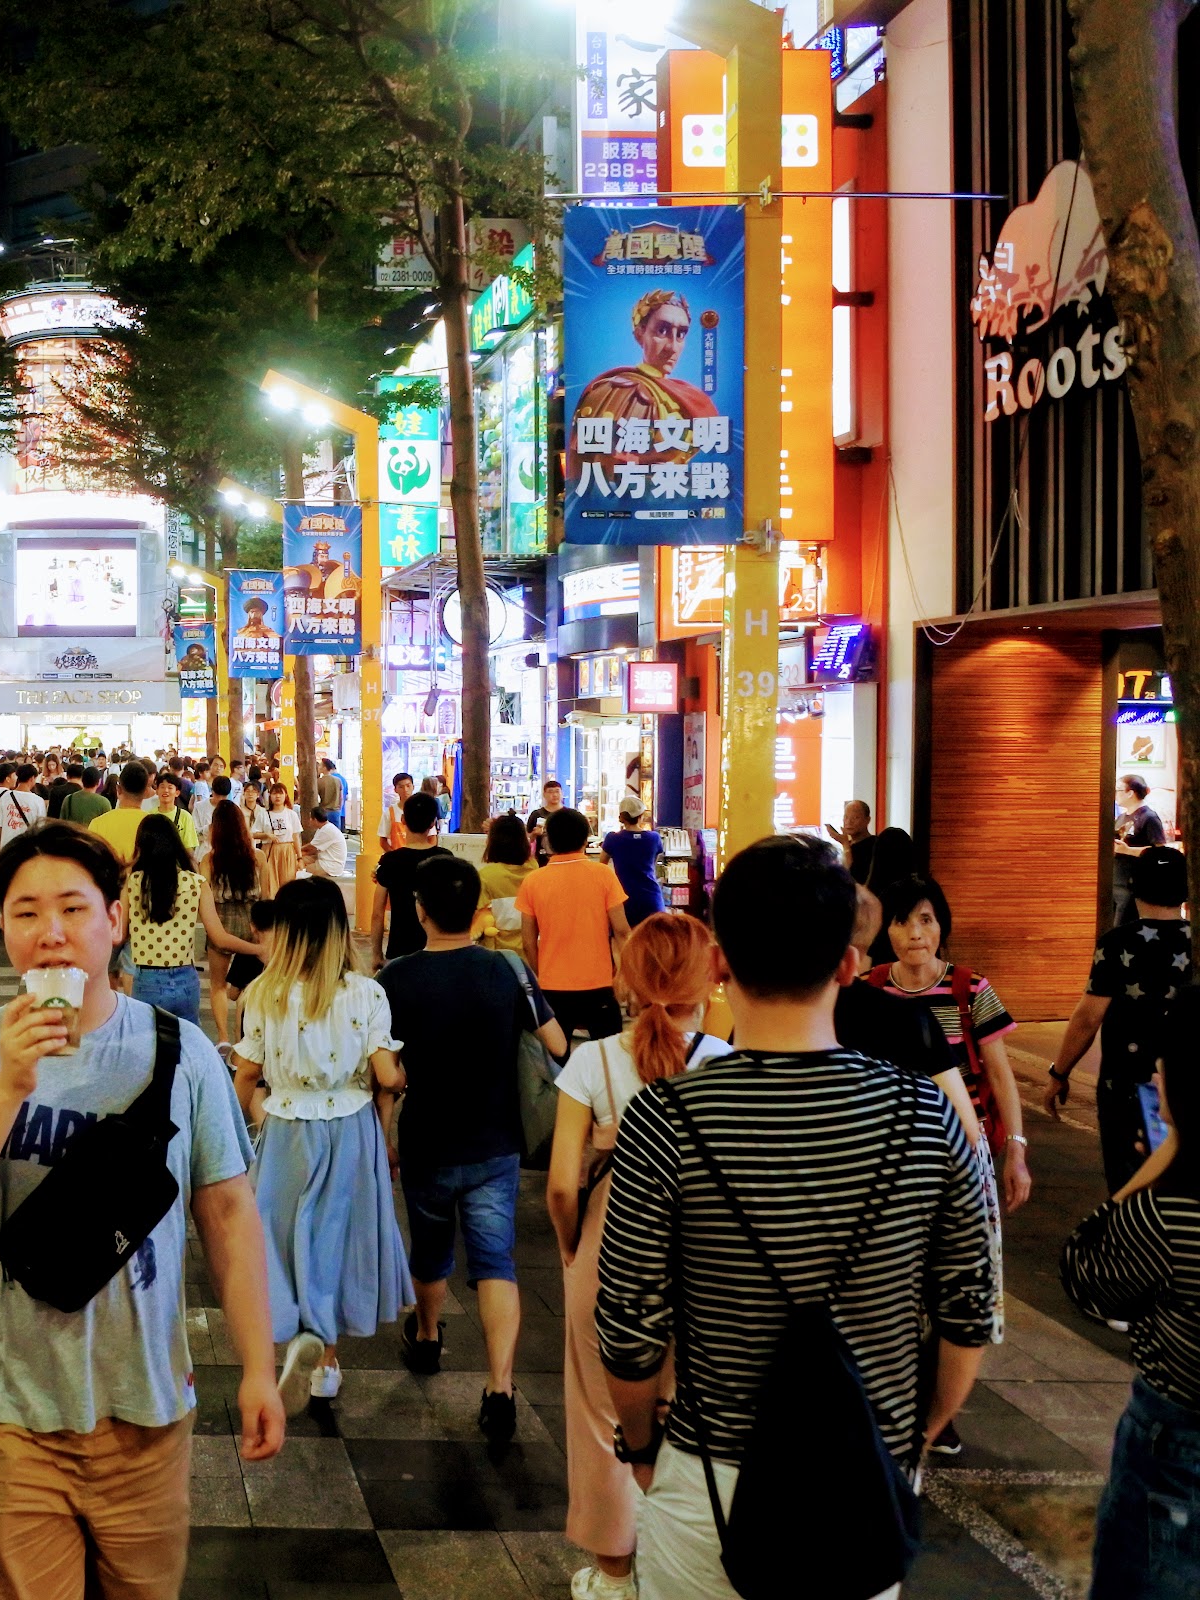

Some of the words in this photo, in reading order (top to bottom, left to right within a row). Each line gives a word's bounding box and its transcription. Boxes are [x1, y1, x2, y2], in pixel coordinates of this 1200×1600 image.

[585, 163, 657, 178] 2388-5
[603, 231, 707, 261] 萬國覺醒
[392, 270, 433, 282] 2381-0009
[984, 324, 1128, 421] Roots
[576, 415, 730, 454] 四海文明
[575, 462, 731, 499] 八方來戰
[387, 504, 426, 562] 叢林
[286, 598, 356, 615] 四海文明
[790, 593, 817, 612] 25
[287, 618, 356, 635] 八方來戰
[745, 608, 768, 636] H
[367, 682, 377, 694] H
[737, 671, 774, 698] 39
[16, 690, 48, 704] THE
[52, 690, 94, 704] FACE
[97, 690, 142, 704] SHOP
[284, 698, 293, 708] H
[282, 717, 295, 727] 35
[364, 708, 380, 721] 37
